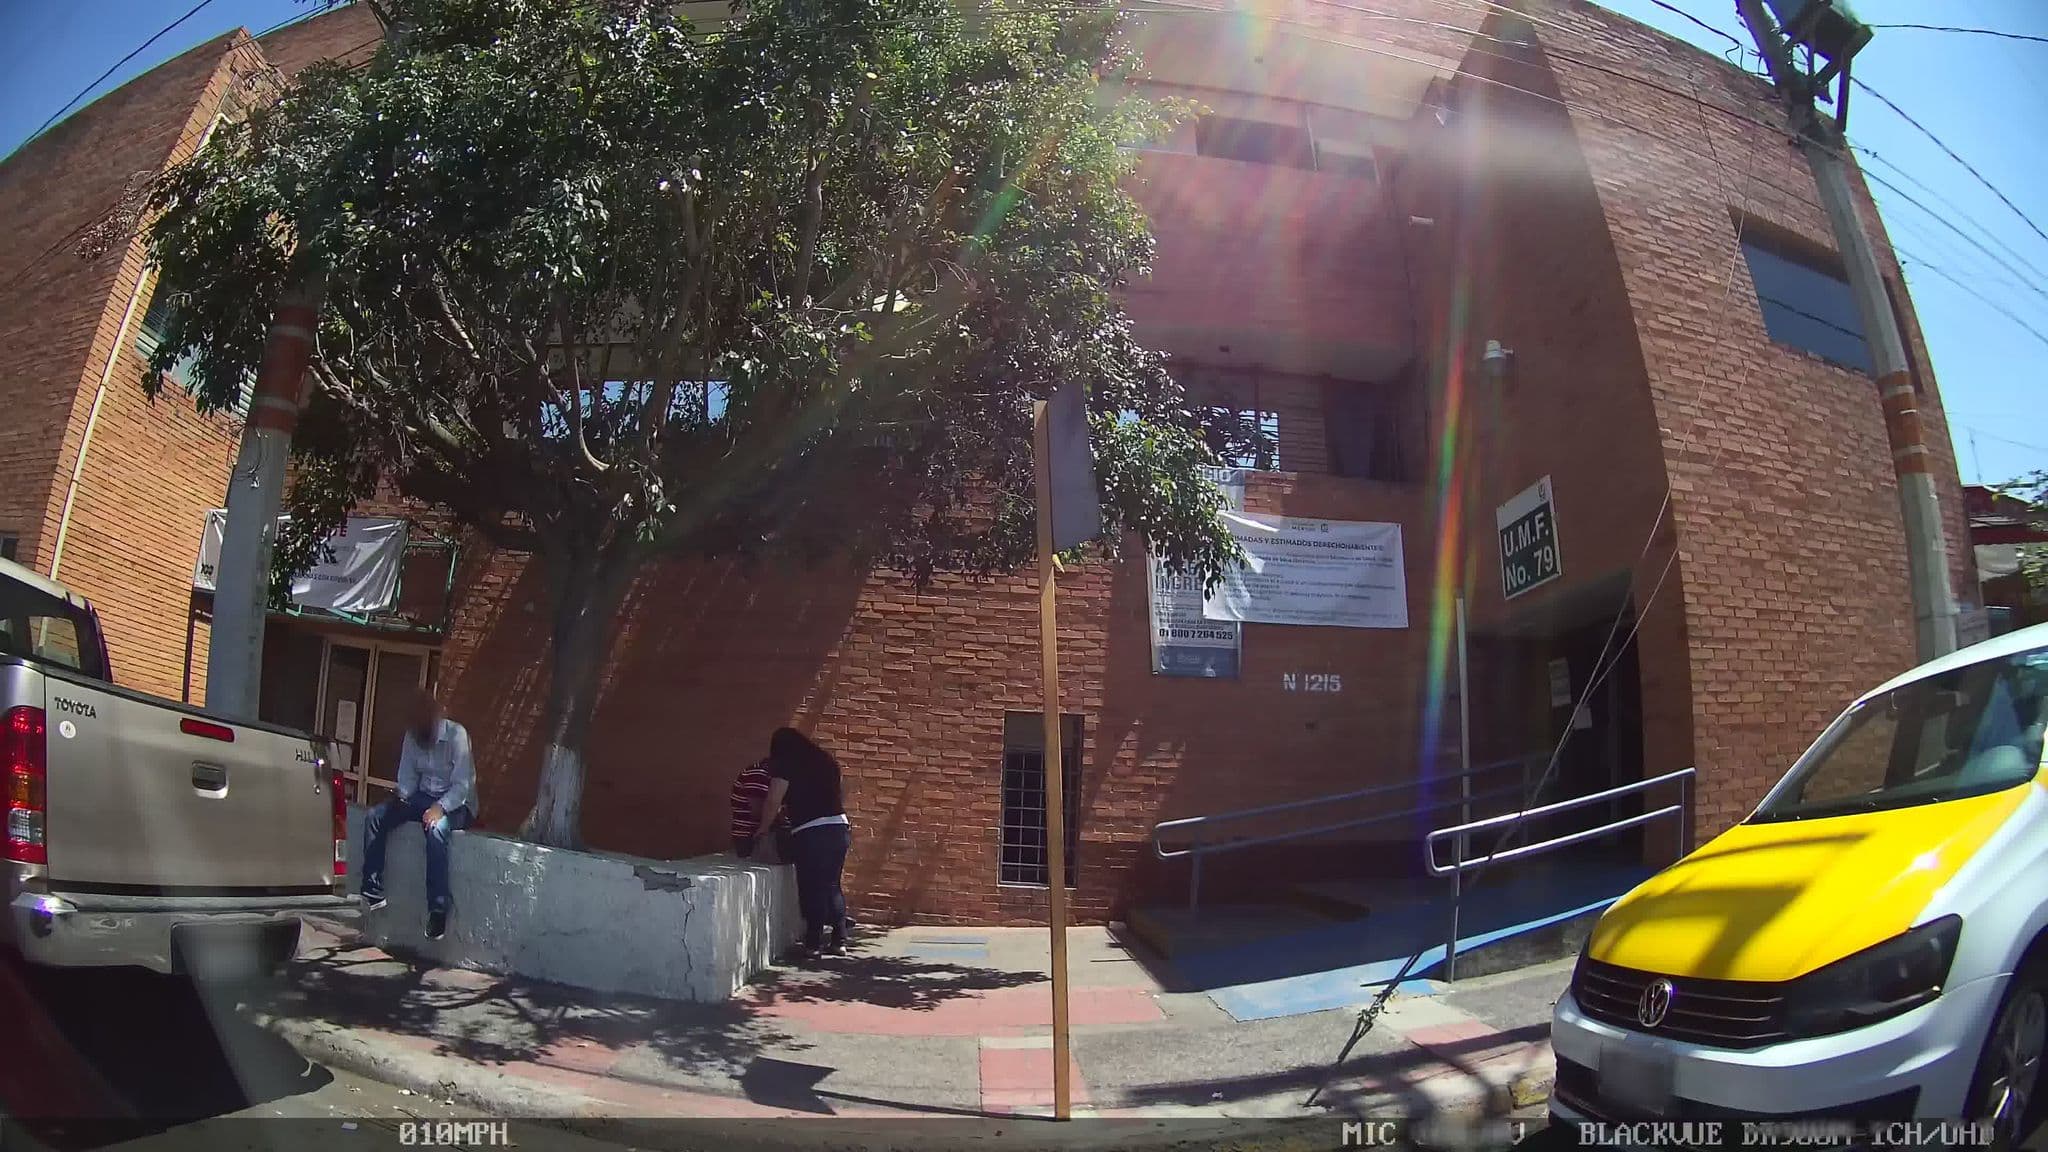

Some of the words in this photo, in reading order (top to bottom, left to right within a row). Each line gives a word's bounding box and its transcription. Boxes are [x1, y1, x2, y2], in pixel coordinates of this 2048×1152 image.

[1271, 538, 1311, 547] ESTIMADOS
[1504, 511, 1549, 557] U.M.F.
[1505, 563, 1531, 591] No.
[1534, 545, 1554, 577] 79
[1155, 575, 1202, 591] INGRE
[1304, 673, 1342, 691] 1215
[54, 696, 97, 719] TOYOTA
